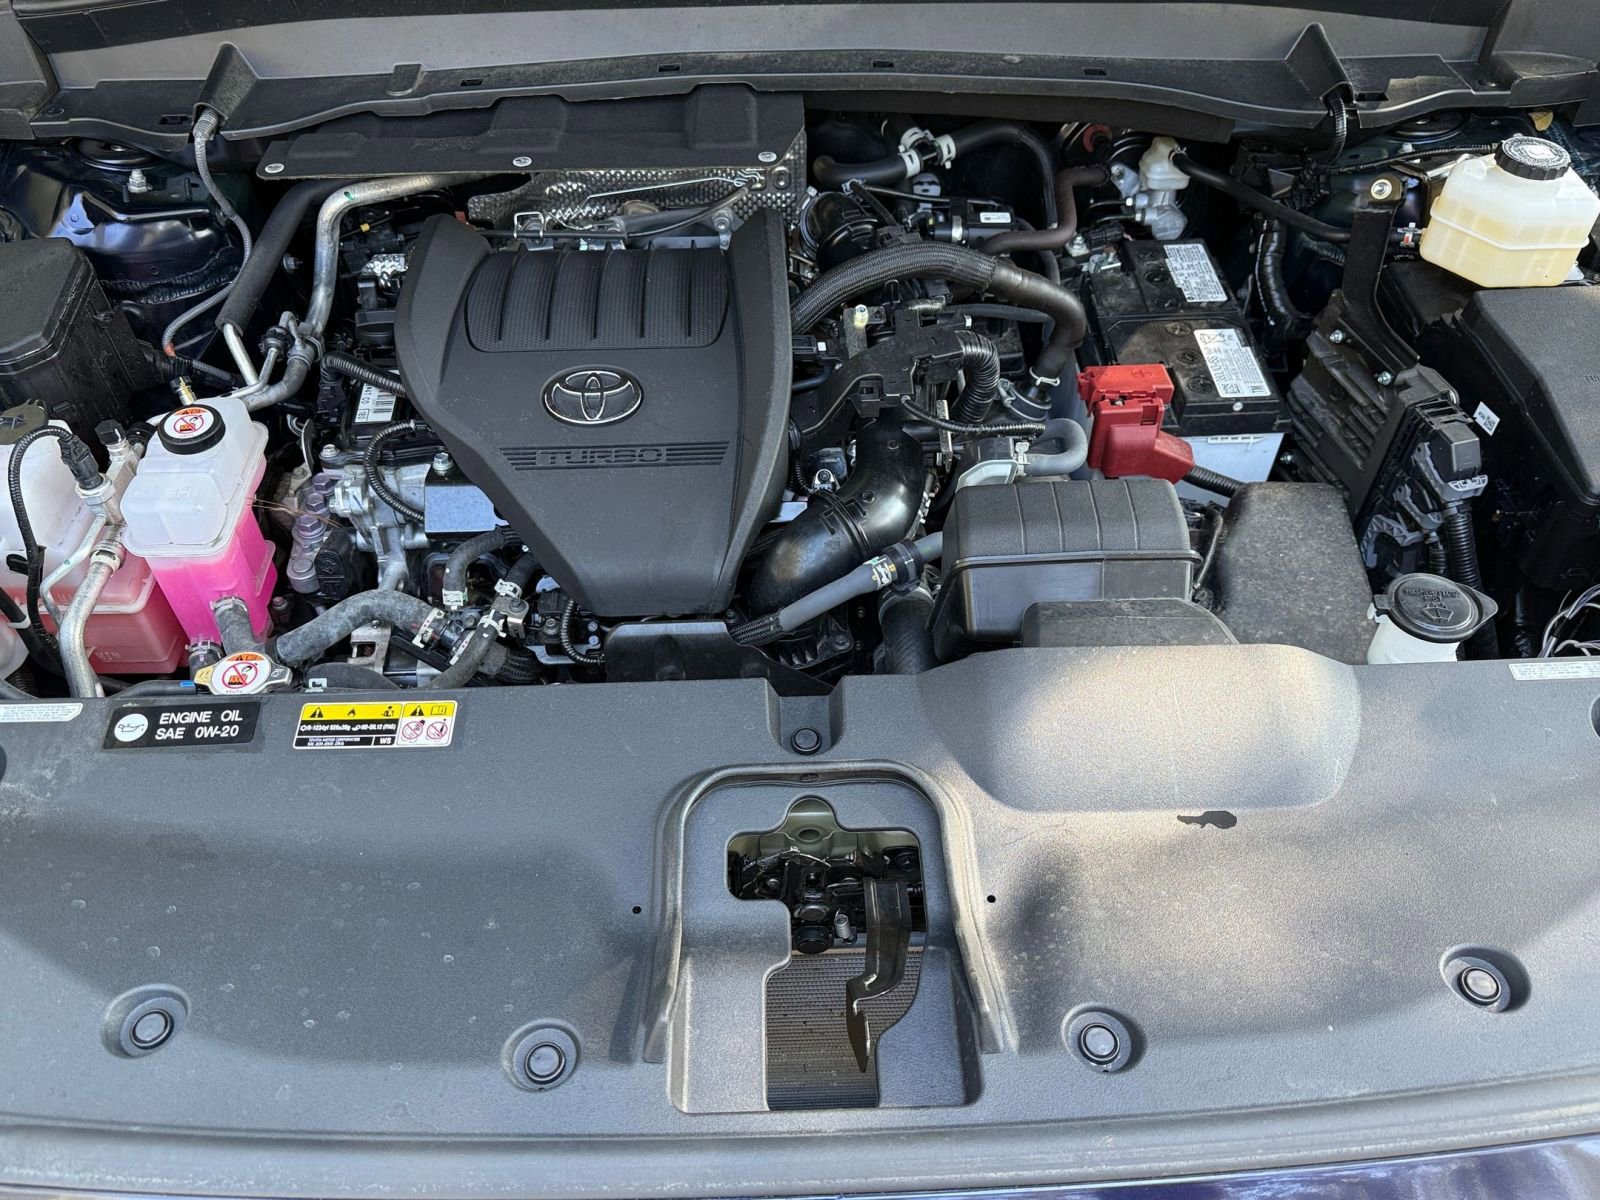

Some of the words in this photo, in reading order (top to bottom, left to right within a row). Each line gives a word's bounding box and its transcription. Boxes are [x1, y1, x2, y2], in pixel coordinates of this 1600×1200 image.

[539, 447, 663, 465] TURBO
[159, 710, 213, 725] ENGINE
[220, 709, 243, 722] OIL
[154, 727, 186, 740] SAE
[194, 725, 239, 738] 0W-20
[379, 737, 392, 745] WS
